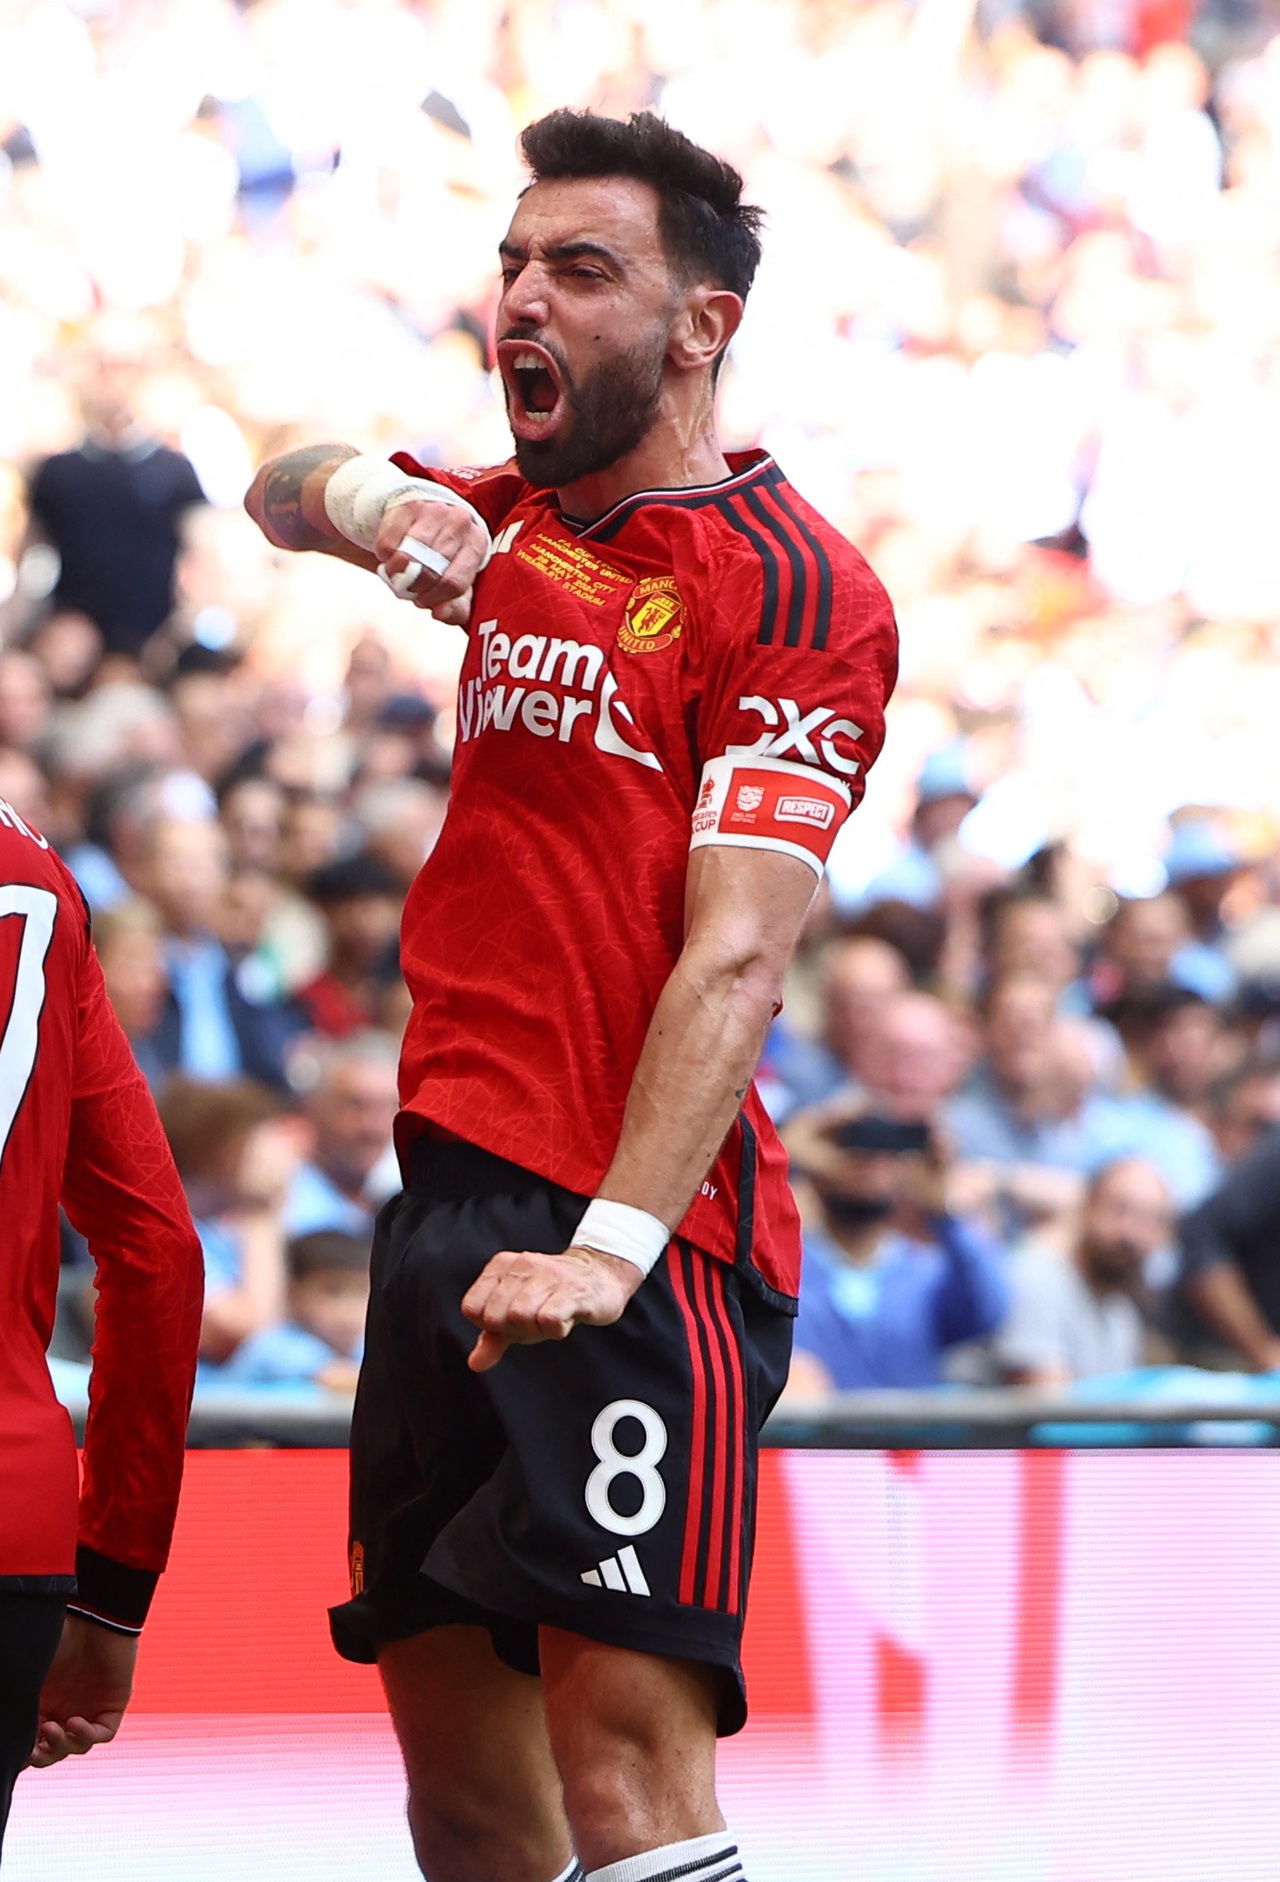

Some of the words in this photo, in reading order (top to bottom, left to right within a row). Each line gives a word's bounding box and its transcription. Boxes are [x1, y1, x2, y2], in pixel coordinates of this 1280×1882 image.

[516, 549, 562, 582] WEMBLEY
[561, 581, 606, 606] STADIUM
[529, 543, 592, 582] MANCHESTER
[593, 581, 617, 593] CITY
[536, 533, 599, 571] MANCHESTER
[600, 568, 633, 584] UNITED
[550, 563, 574, 580] MAY
[573, 579, 597, 594] 2024
[640, 579, 677, 594] MANC
[478, 618, 605, 692] Team
[617, 625, 656, 650] UNITED
[781, 800, 828, 820] RESPECT
[584, 1399, 668, 1536] 8
